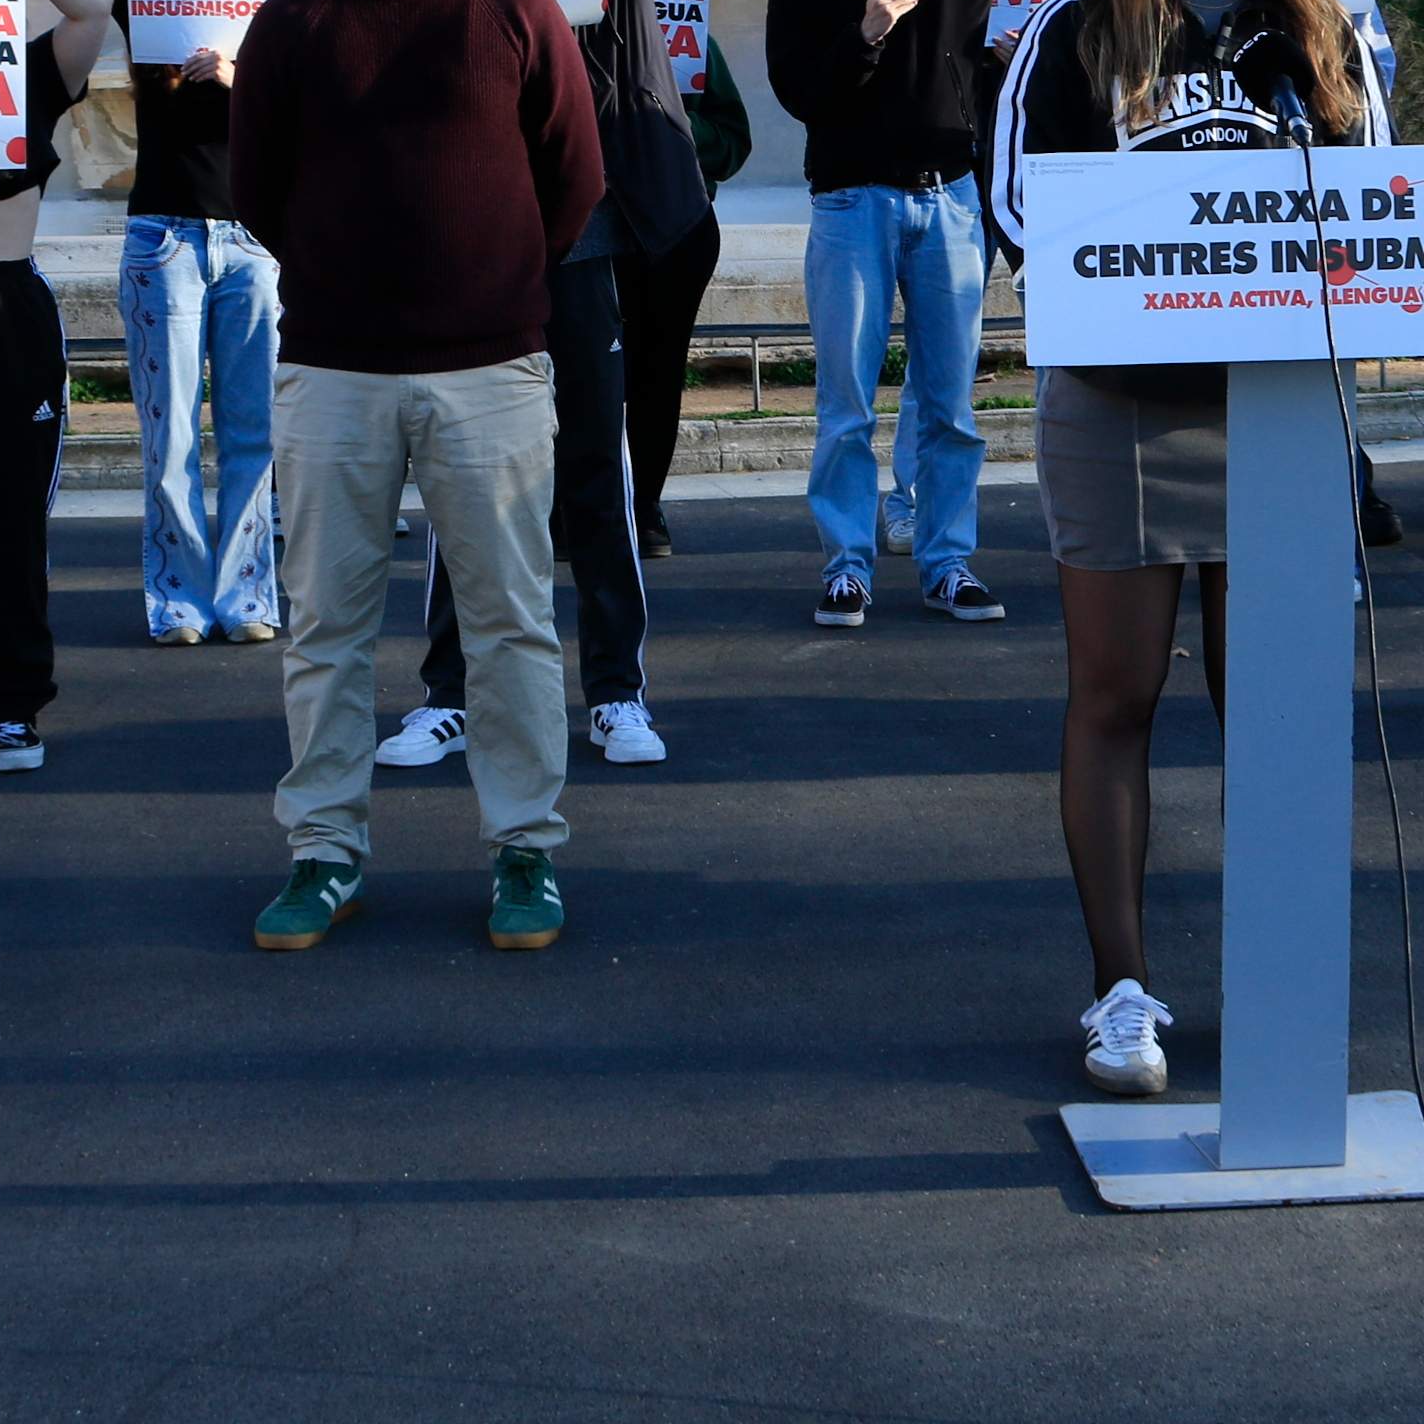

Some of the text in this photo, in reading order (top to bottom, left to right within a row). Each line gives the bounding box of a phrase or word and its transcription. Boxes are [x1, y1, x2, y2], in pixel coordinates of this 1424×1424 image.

[1181, 127, 1248, 148] LONDON
[1190, 188, 1415, 225] XARXA DE
[1073, 241, 1258, 278] CENTRES
[1143, 292, 1223, 310] XARXA
[1229, 289, 1313, 308] ACTIVA,
